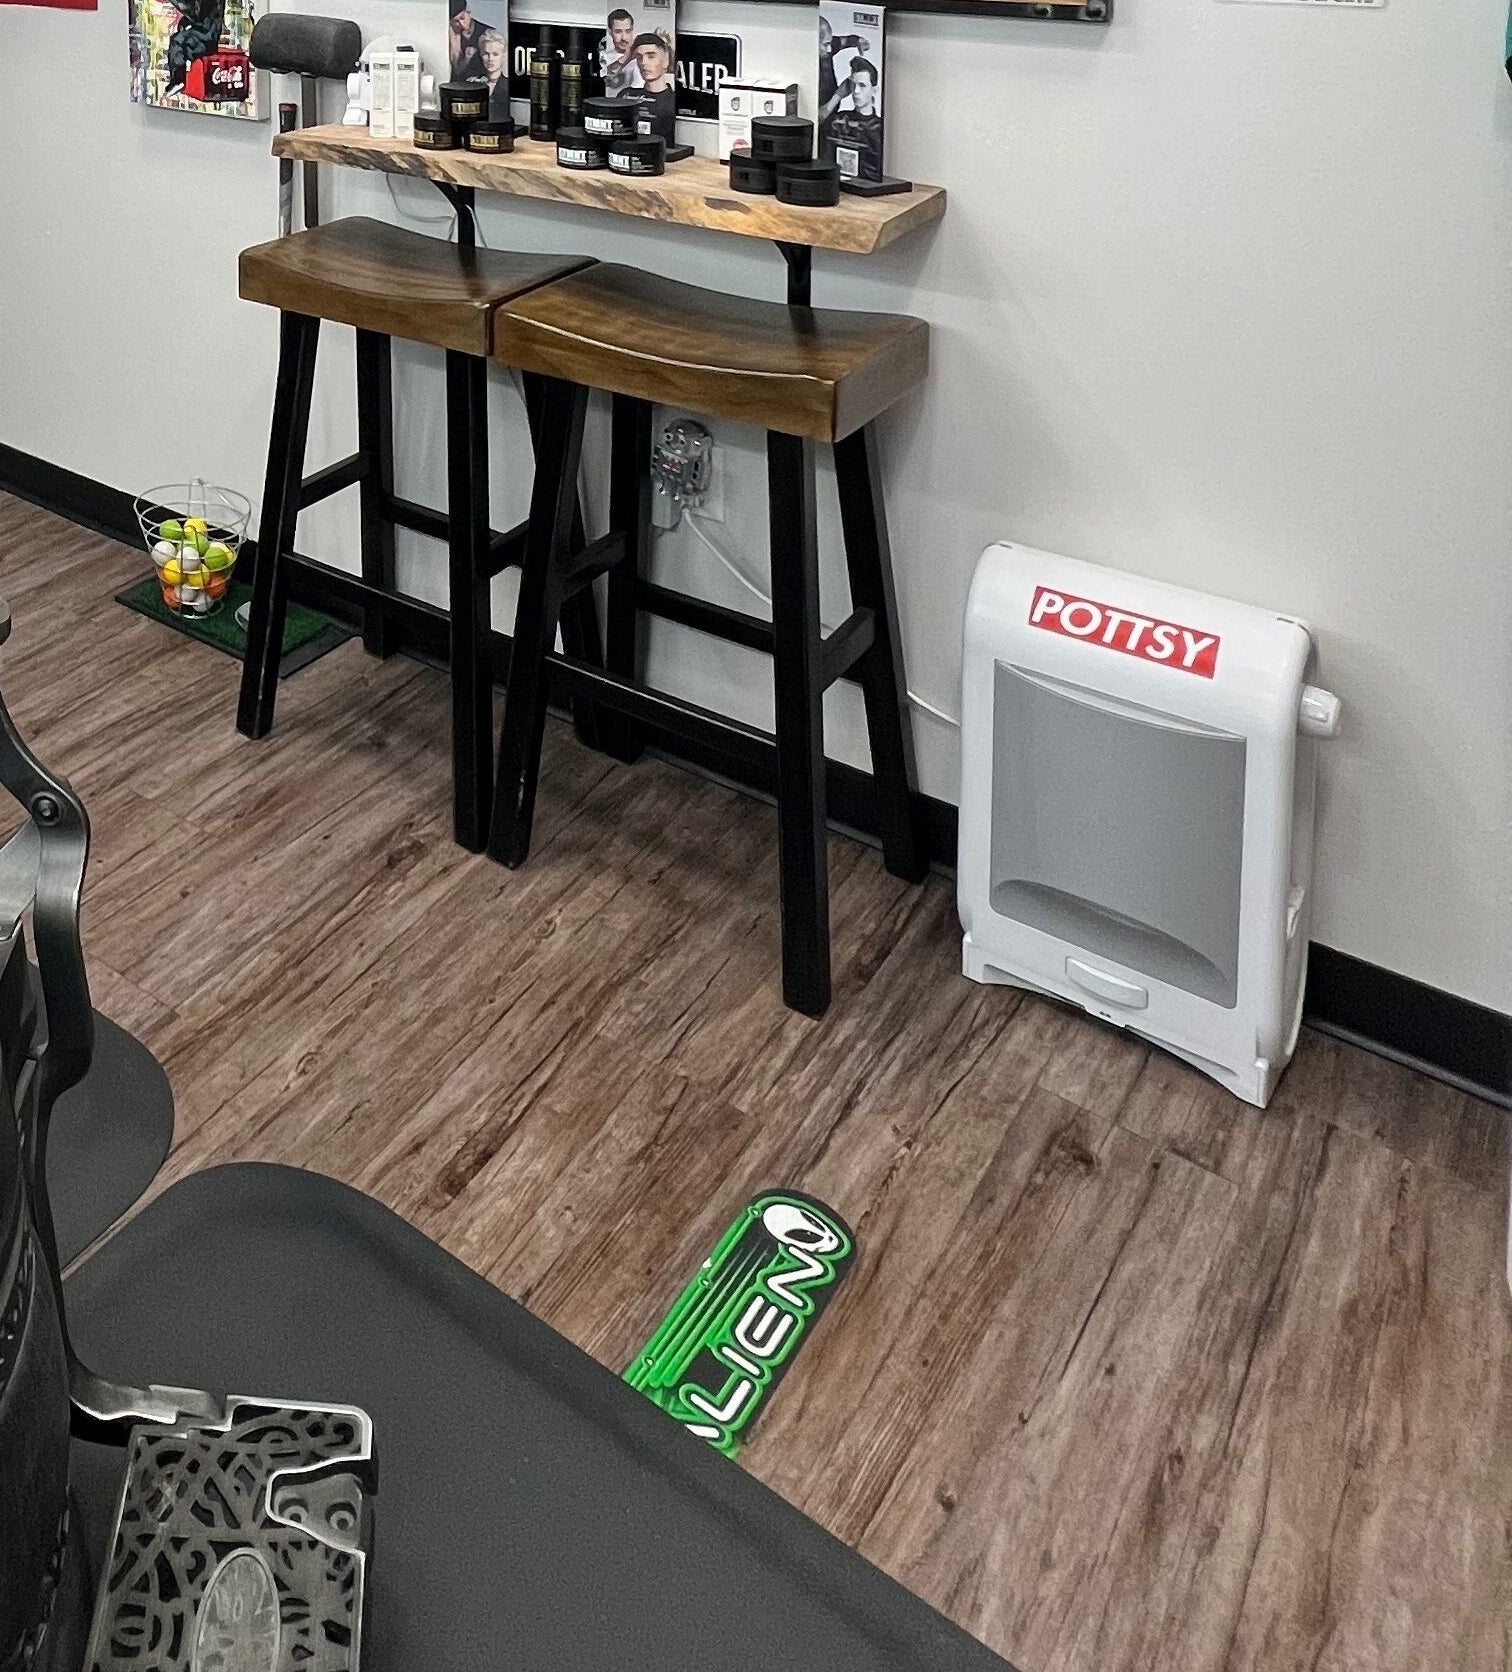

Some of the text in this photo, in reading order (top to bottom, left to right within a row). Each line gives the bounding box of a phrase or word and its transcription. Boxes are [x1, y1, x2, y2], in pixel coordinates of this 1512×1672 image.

[676, 60, 729, 96] ALER
[1031, 591, 1216, 668] POTTSY
[686, 1246, 825, 1439] LIEN
